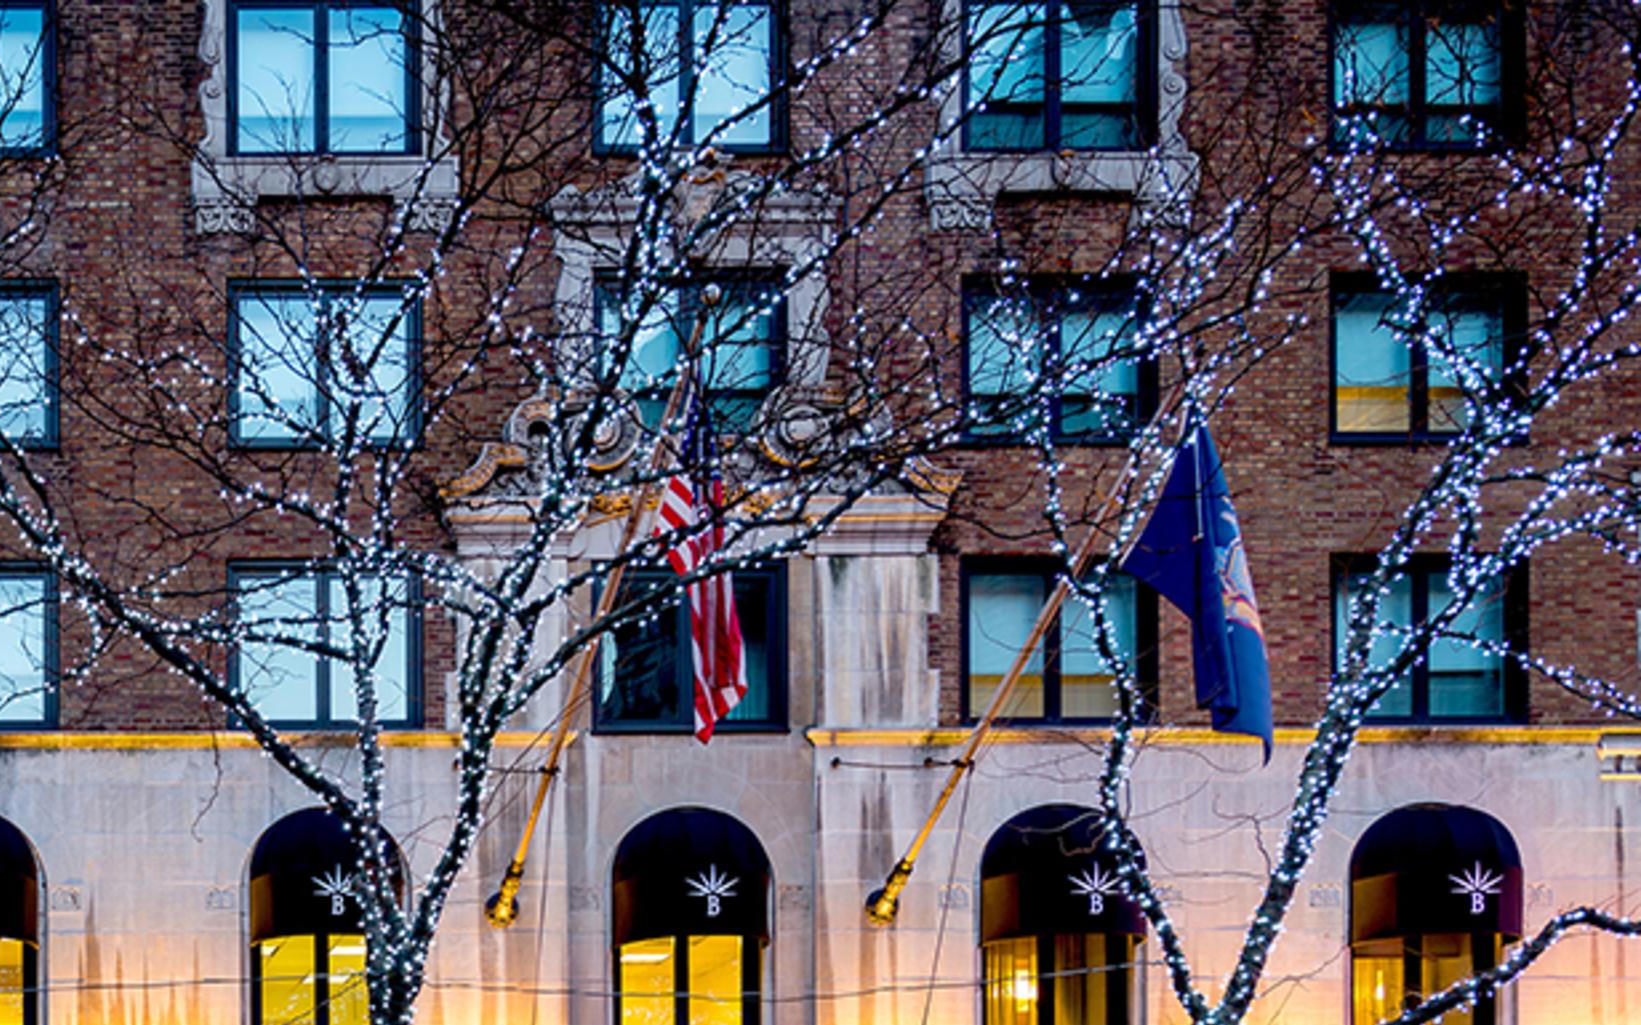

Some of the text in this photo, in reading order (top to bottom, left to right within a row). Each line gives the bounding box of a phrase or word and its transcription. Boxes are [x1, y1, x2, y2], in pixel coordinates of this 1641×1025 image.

[331, 894, 345, 915] B
[707, 895, 721, 916] B
[1089, 893, 1104, 915] B
[1470, 892, 1485, 914] B
